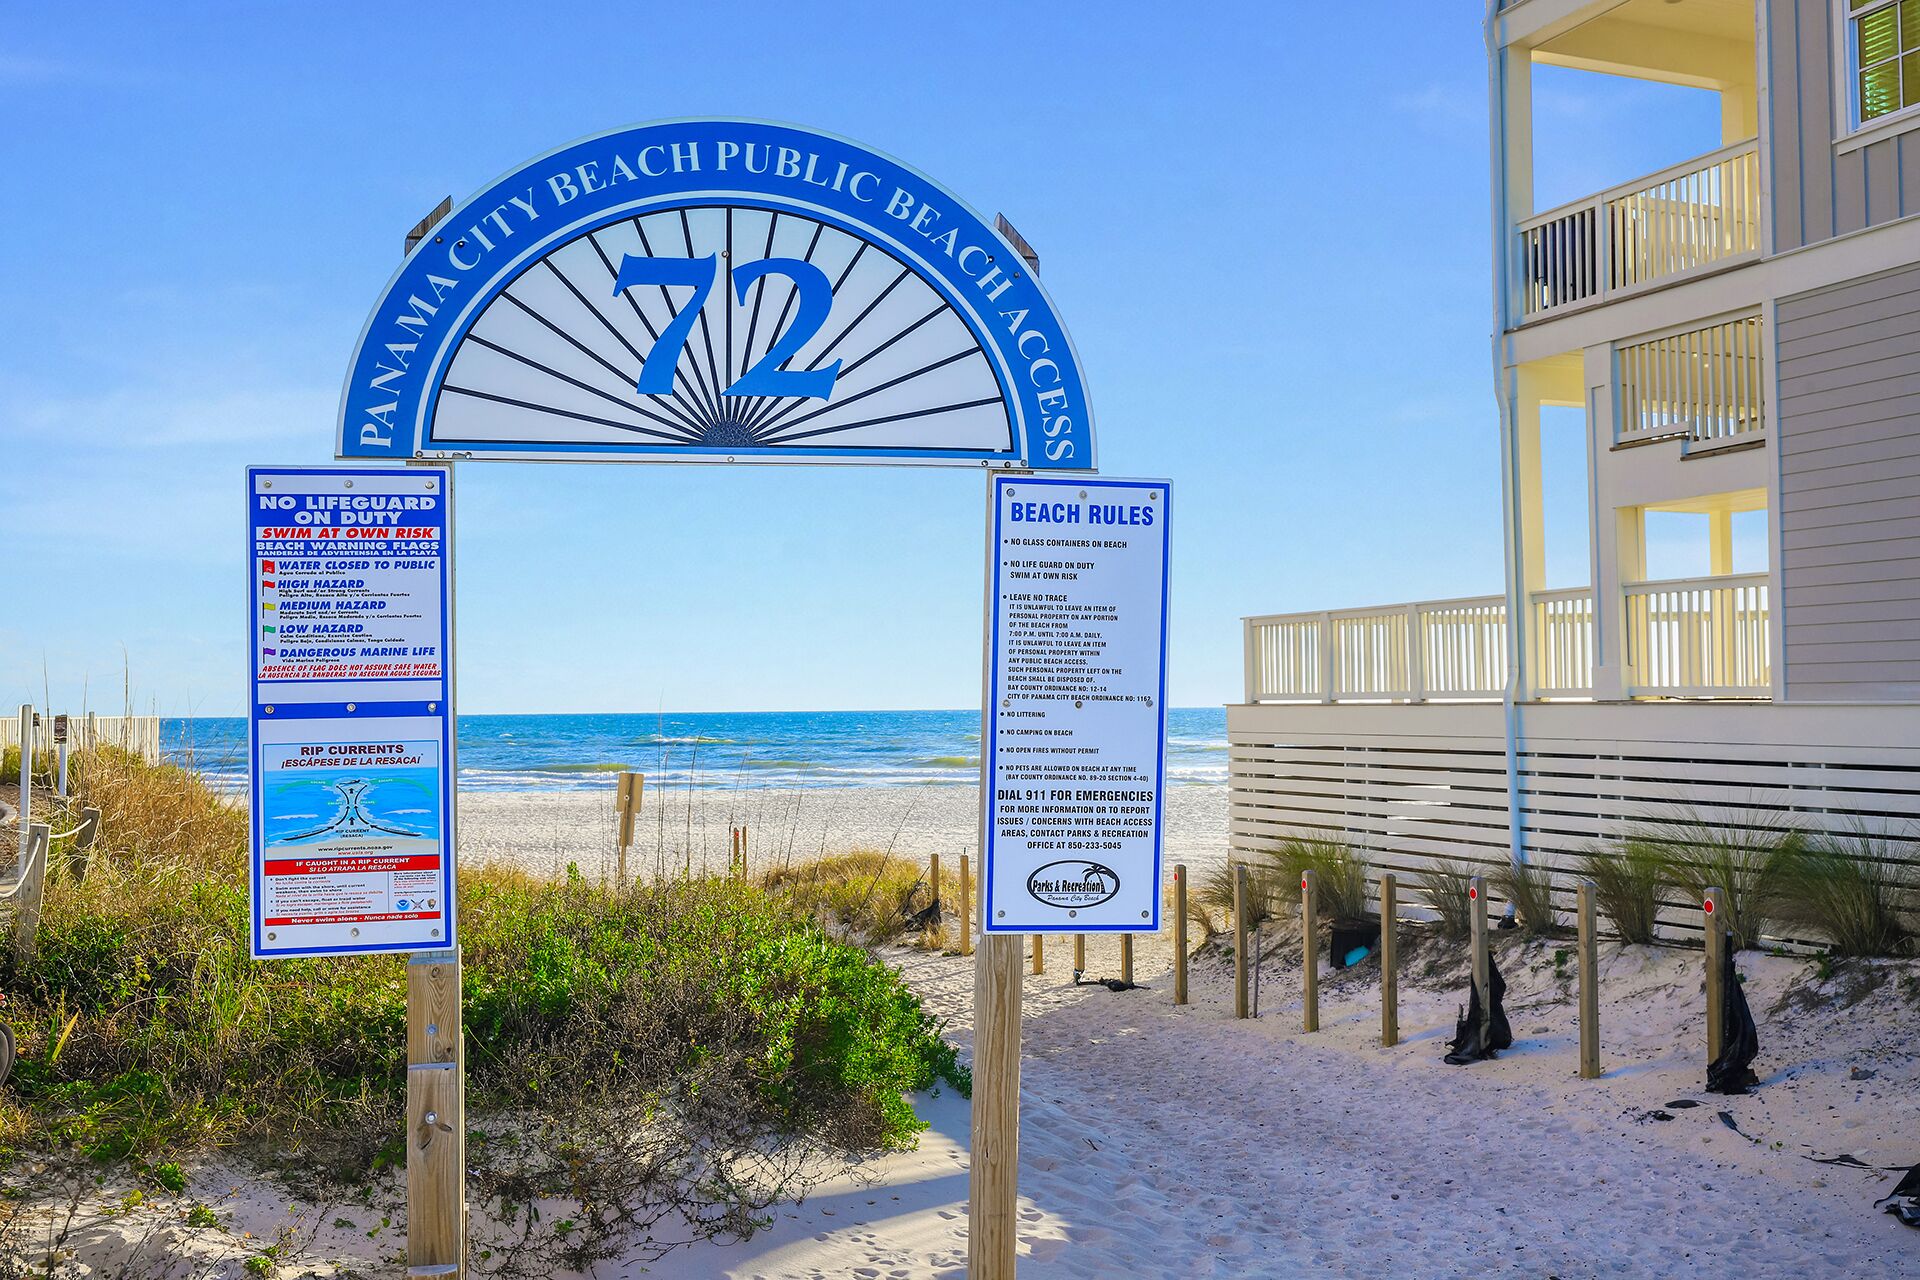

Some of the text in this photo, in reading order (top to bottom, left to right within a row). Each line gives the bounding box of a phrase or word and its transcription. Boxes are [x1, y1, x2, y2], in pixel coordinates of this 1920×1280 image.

[360, 141, 1075, 461] PANAMA CITY BEACH PUBLIC BEACH ACCESS
[612, 251, 844, 401] 72
[259, 496, 435, 510] NO LIFEGUARD
[294, 511, 402, 525] ON DUTY
[1011, 503, 1153, 525] BEACH RULES
[261, 528, 434, 539] SWIM AT OWN RISK
[256, 542, 439, 550] BEACH WARNING FLAGS
[1046, 539, 1089, 548] CONTAINERS
[1091, 540, 1101, 548] ON
[278, 561, 435, 570] WATER CLOSED TO PUBLIC
[1022, 561, 1036, 569] LIFE
[1039, 561, 1062, 569] GUARD
[1076, 562, 1094, 570] DUTY
[1043, 572, 1059, 580] OWN
[1061, 572, 1077, 580] RISK
[277, 580, 364, 589] HIGH HAZARD
[1045, 594, 1067, 602] TRACE
[279, 601, 386, 610] MEDIUM HAZARD
[279, 624, 364, 634] LOW HAZARD
[279, 647, 435, 658] DANGEROUS MARINE LIFE
[300, 745, 403, 756] RIP CURRENTS
[342, 757, 357, 767] DE
[358, 757, 373, 767] LA
[1044, 774, 1076, 782] ORDINANCE
[997, 790, 1152, 801] DIAL 911 FOR EMERGENCIES
[1000, 805, 1015, 813] FOR
[1096, 806, 1106, 814] OR
[1108, 806, 1118, 814] TO
[1120, 806, 1149, 814] REPORT
[997, 817, 1023, 825] ISSUES
[1031, 818, 1071, 826] CONCERNS
[1074, 818, 1093, 826] WITH
[1096, 818, 1120, 826] BEACH
[1123, 818, 1152, 826] ACCESS
[1033, 880, 1100, 892] Parks & Recreation
